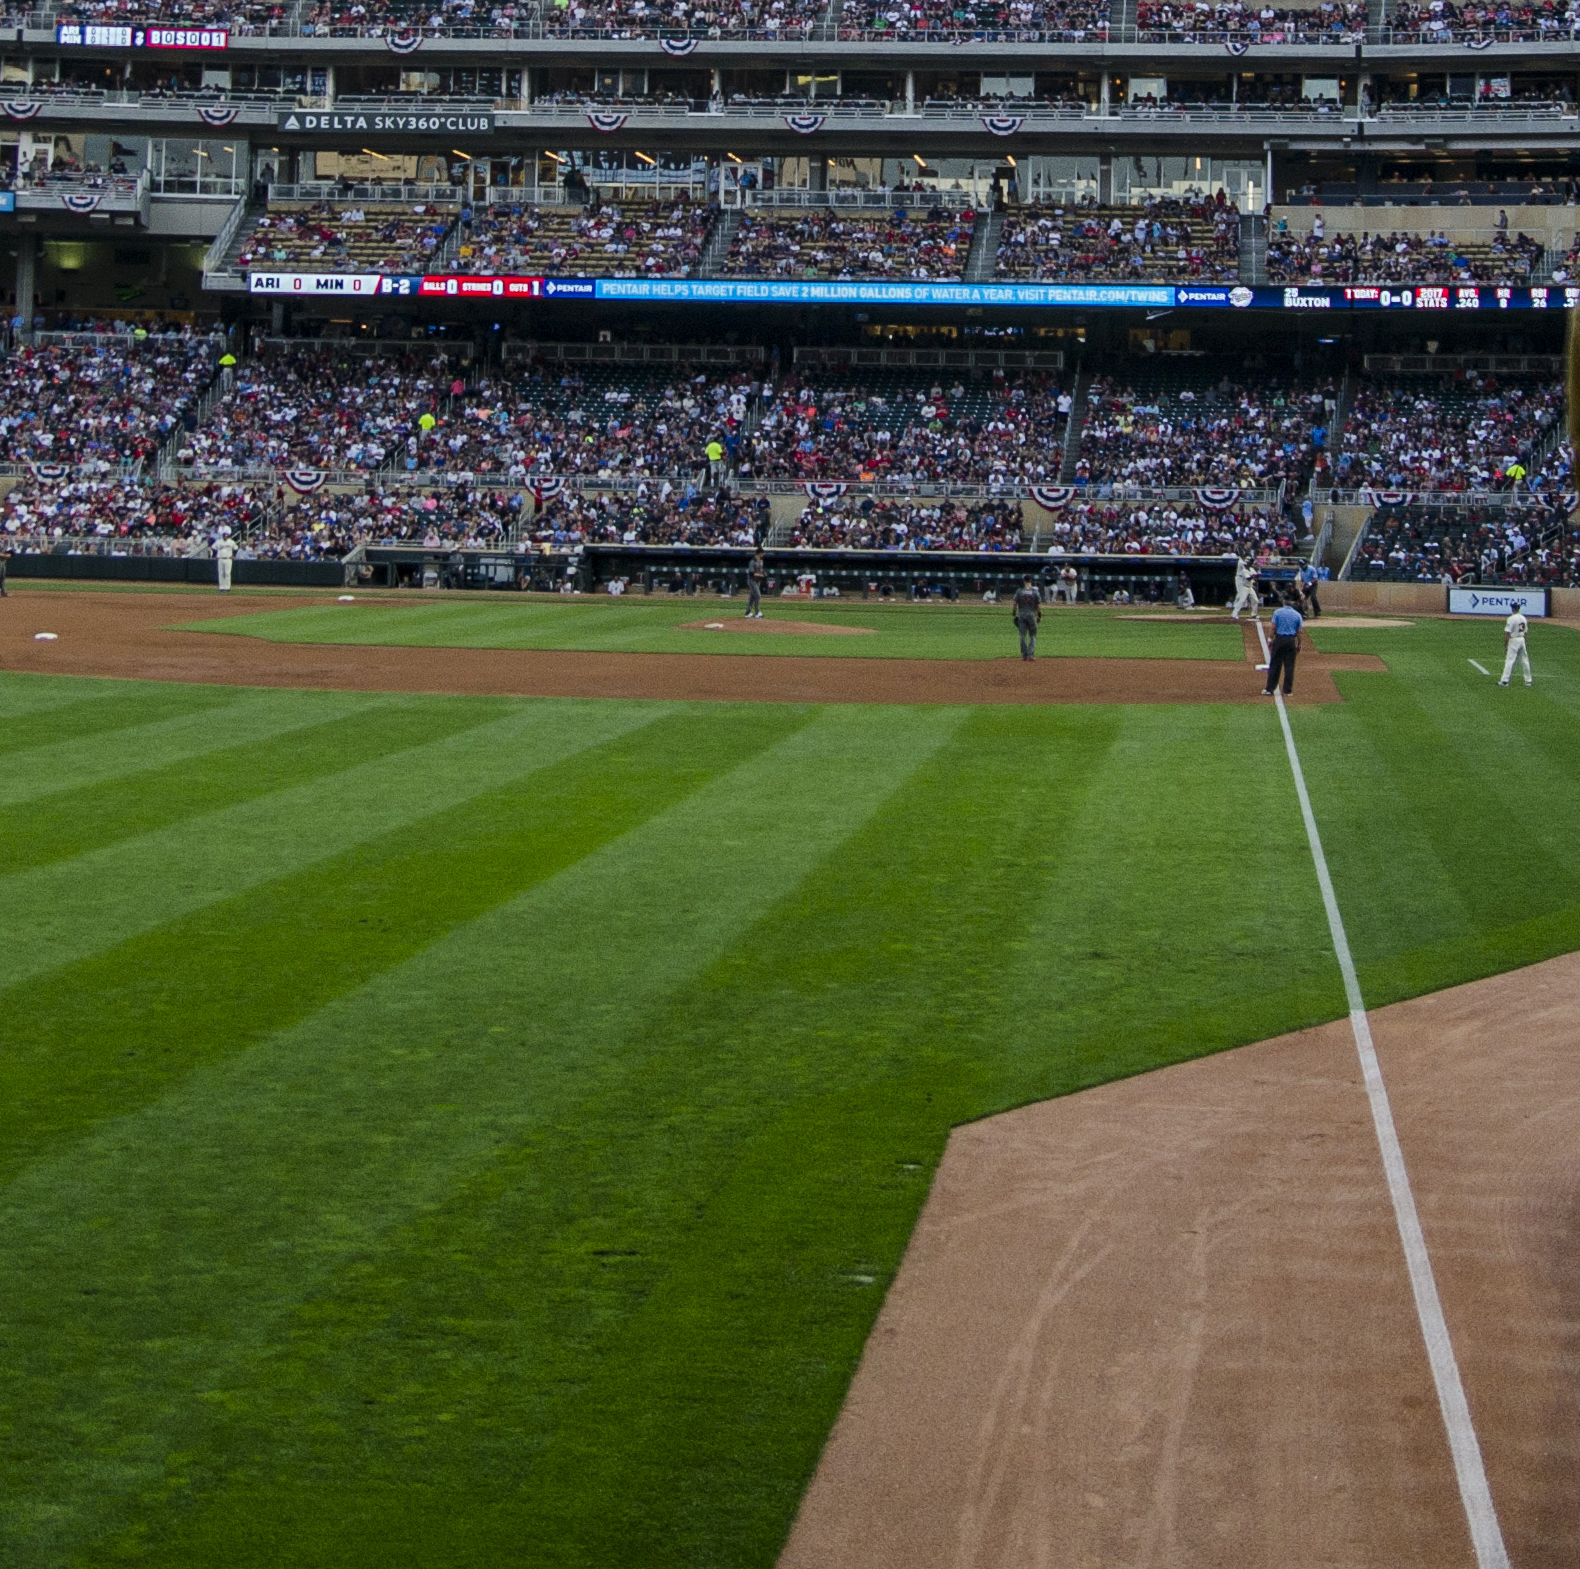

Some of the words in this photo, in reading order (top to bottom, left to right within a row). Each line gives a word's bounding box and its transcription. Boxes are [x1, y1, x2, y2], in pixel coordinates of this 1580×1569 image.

[305, 115, 368, 129] DELTA
[254, 277, 280, 289] ARI
[293, 278, 302, 290] 0
[315, 278, 344, 290] MIN
[353, 279, 361, 291] 0
[423, 281, 446, 291] BALLS
[447, 279, 458, 294] 0
[462, 282, 492, 292] STRIKES
[493, 279, 503, 295] 0
[509, 283, 528, 292] OUTS
[532, 280, 540, 295] 1
[556, 284, 593, 292] PENTAIR
[602, 283, 649, 295] PENTAIR
[652, 284, 689, 296] HELPS
[691, 284, 734, 296] TARGET
[736, 285, 768, 297] FIELD
[771, 285, 799, 297] SAVE
[801, 285, 809, 298] 2
[810, 286, 857, 298] MILLION
[859, 286, 912, 299] GALLONS
[914, 287, 929, 299] OF
[931, 287, 970, 300] WATER
[972, 288, 980, 300] A
[1017, 289, 1045, 301] VISIT
[1048, 289, 1168, 303] PENTAIR.COM/TWINS
[1189, 292, 1226, 301] PENTAIR
[1419, 288, 1444, 298] 2017
[1531, 288, 1548, 298] RBI
[1284, 297, 1331, 308] BUXTON
[1379, 290, 1413, 307] 0-0
[1416, 298, 1448, 308] STATS
[1481, 597, 1528, 607] PENTAIR
